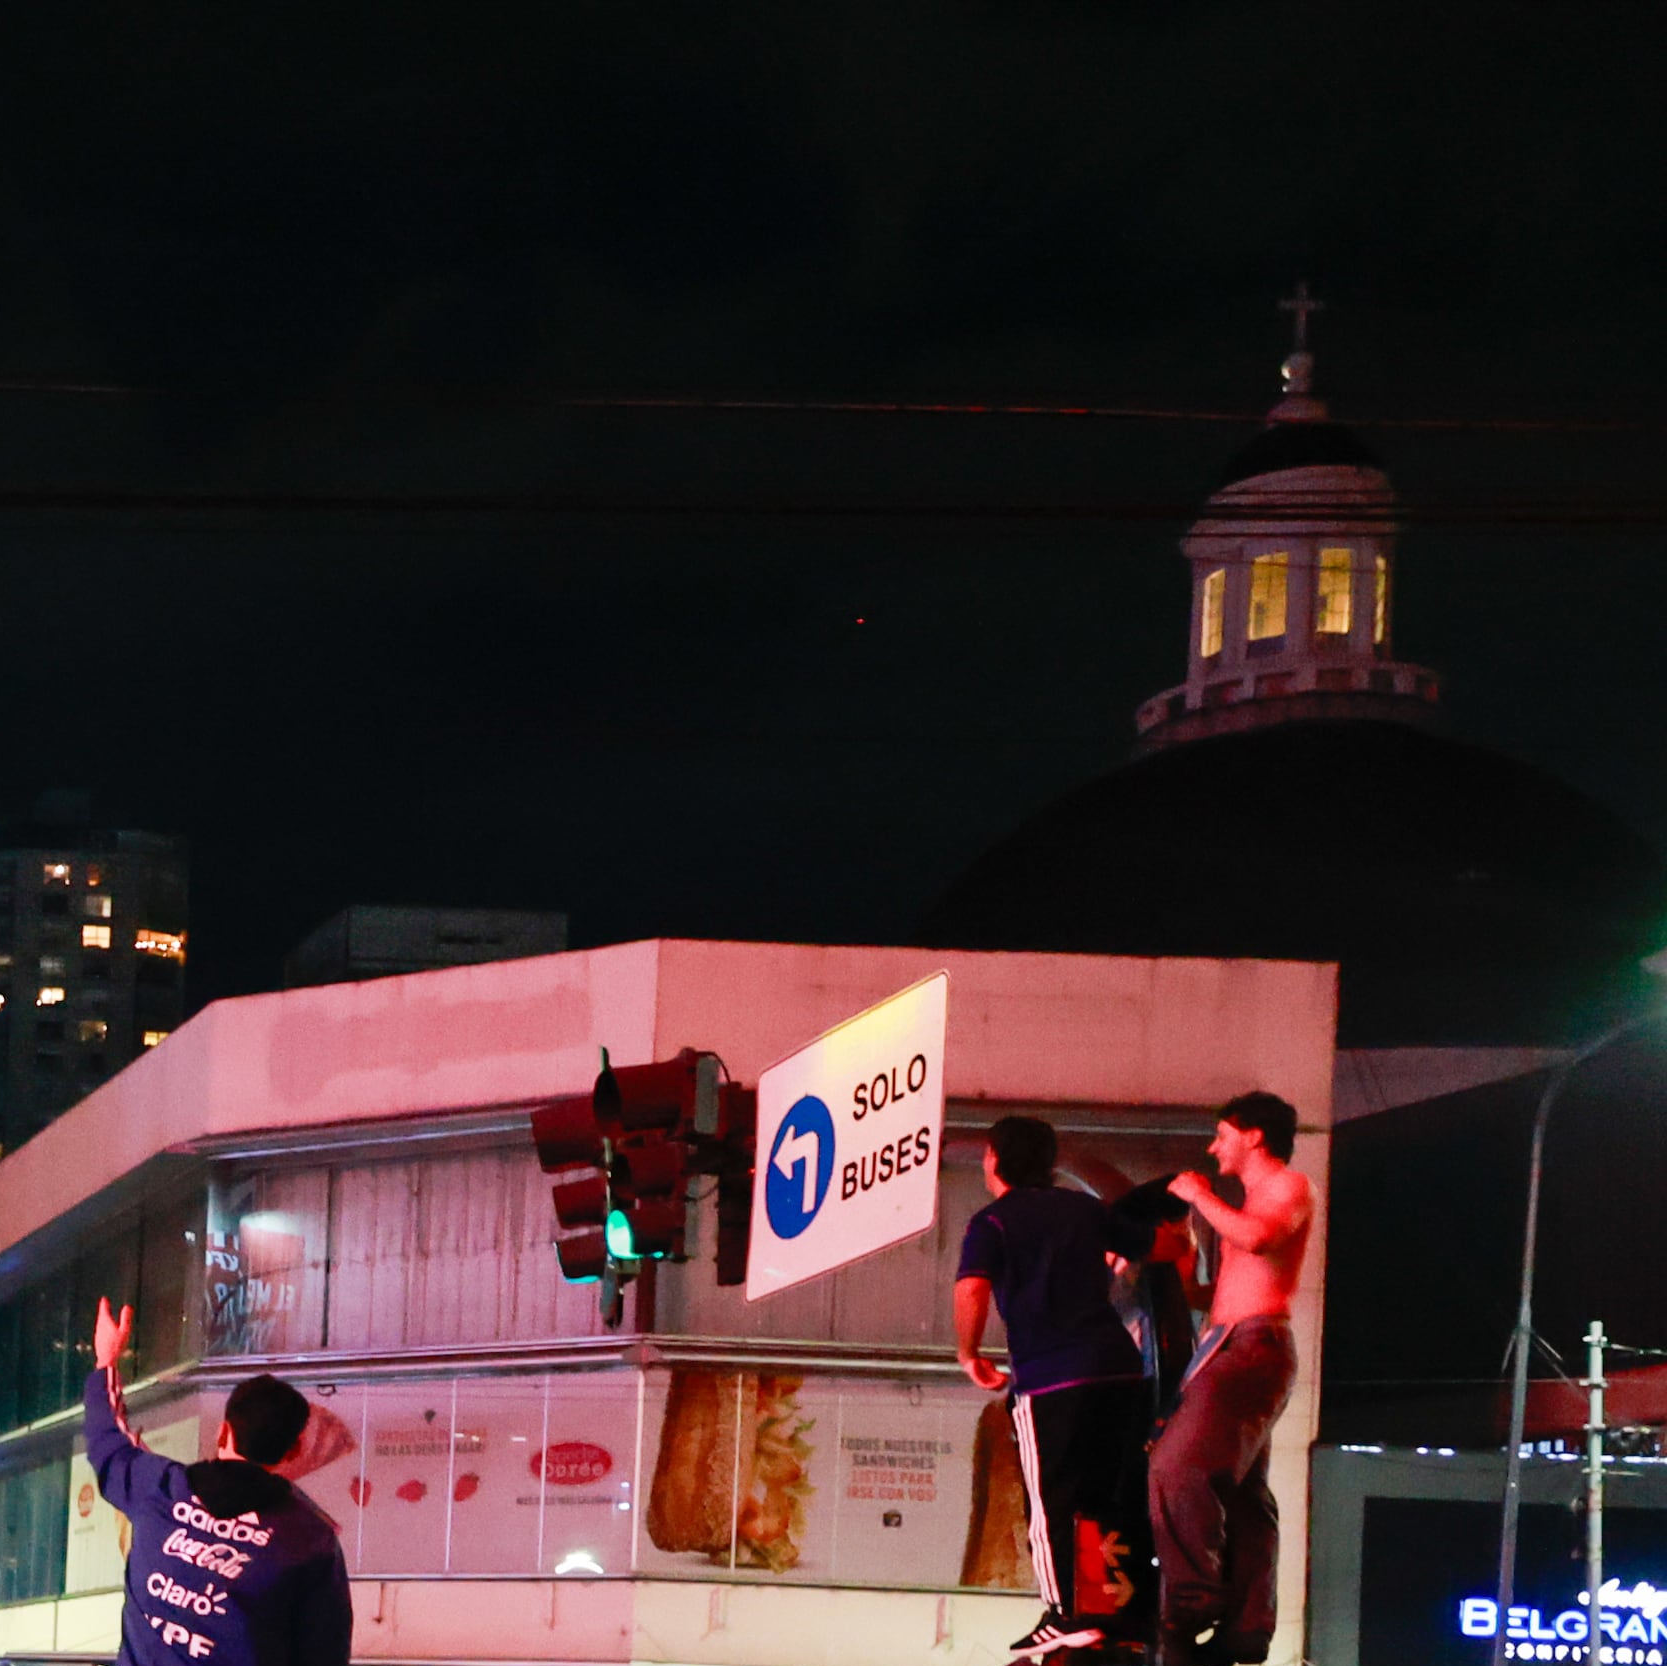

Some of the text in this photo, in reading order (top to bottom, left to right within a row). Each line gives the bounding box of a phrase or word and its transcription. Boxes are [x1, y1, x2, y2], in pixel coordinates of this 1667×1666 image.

[852, 1053, 927, 1122] SOLO
[840, 1127, 931, 1202] BUSES
[852, 1453, 935, 1469] SANDWICHES
[900, 1472, 934, 1486] PARA
[172, 1500, 270, 1547] adidas
[147, 1572, 213, 1616] Claro
